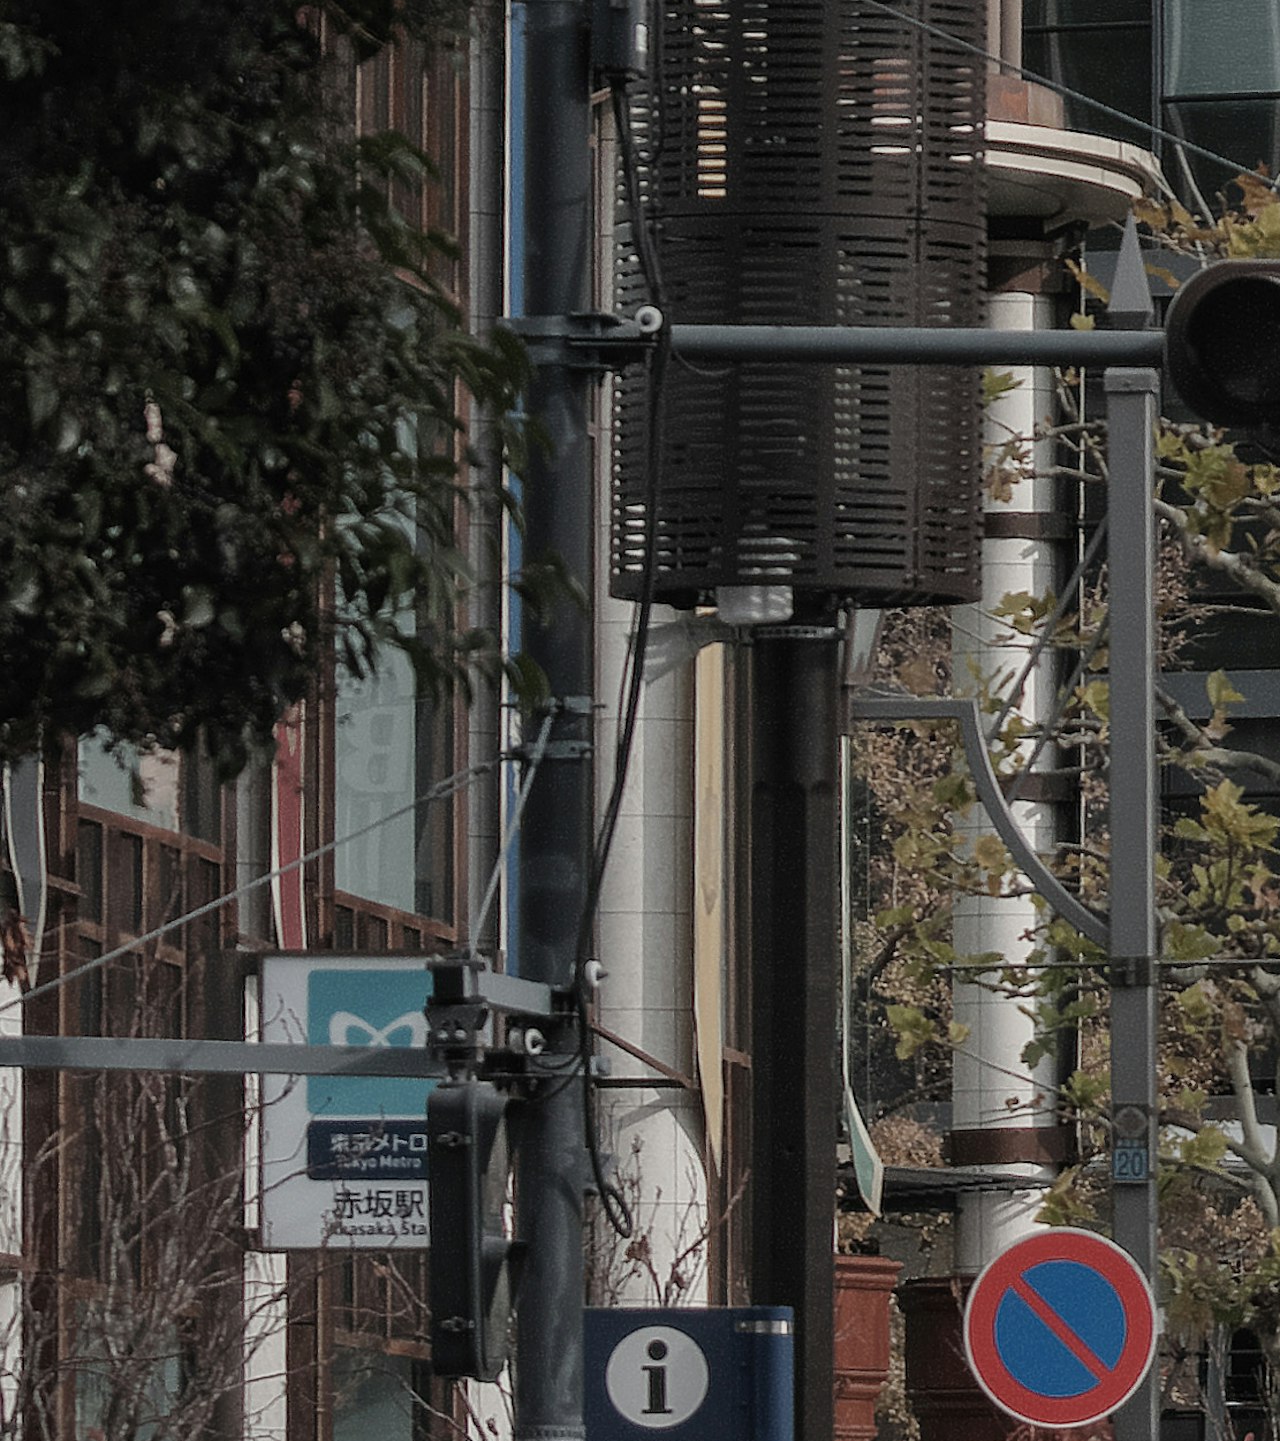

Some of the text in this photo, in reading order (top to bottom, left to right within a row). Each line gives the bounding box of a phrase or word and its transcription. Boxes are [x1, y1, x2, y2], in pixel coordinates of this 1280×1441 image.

[379, 1154, 422, 1169] Metro
[1116, 1151, 1143, 1176] 20
[335, 1189, 425, 1219] 赤坂駅
